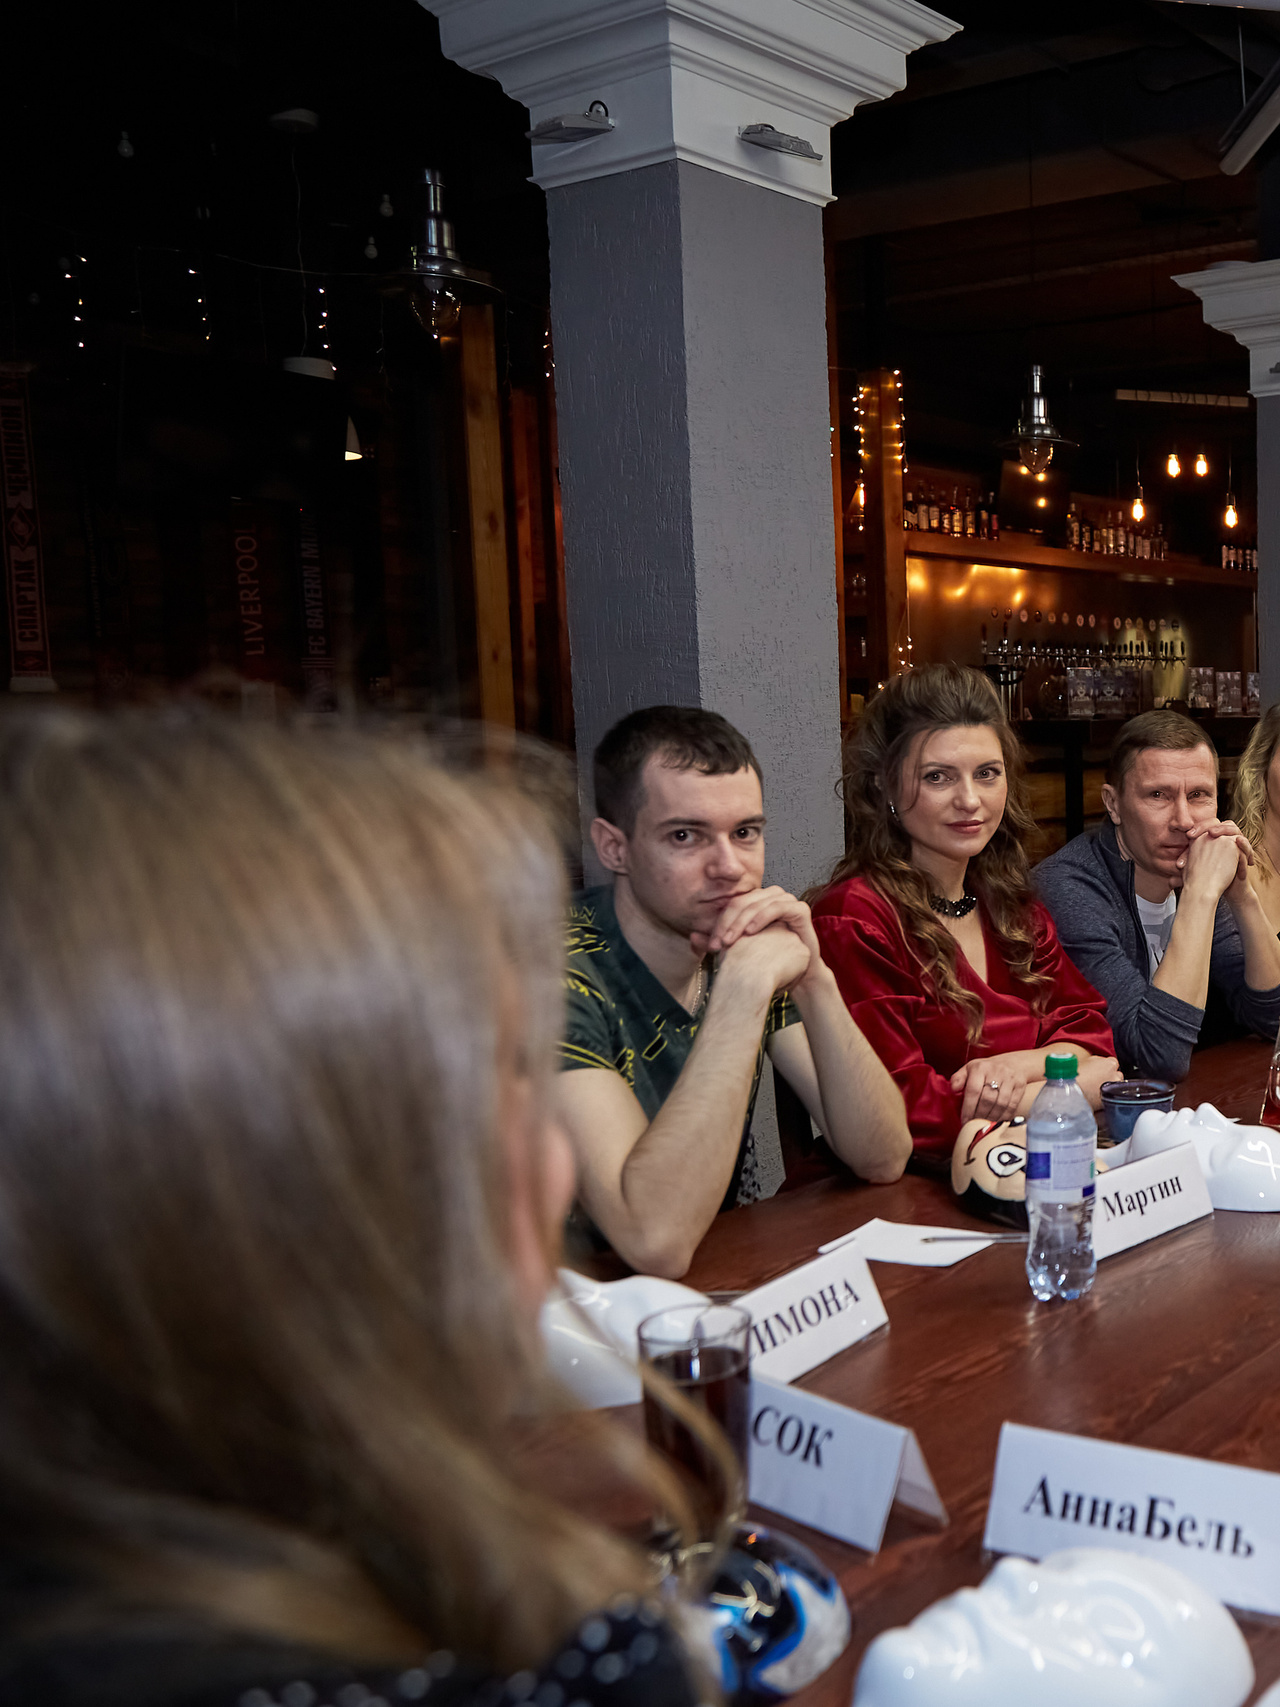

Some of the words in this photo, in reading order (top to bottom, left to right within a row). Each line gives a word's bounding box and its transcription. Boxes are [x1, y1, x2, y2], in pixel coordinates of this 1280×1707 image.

[1, 404, 31, 498] ЧЕМПИОН
[18, 558, 40, 643] СПАРТАК
[233, 527, 265, 656] LIVERPOOL
[303, 565, 325, 629] BAYERN
[1102, 1175, 1183, 1222] Мартин
[751, 1278, 861, 1361] ИМОНА
[1023, 1473, 1255, 1558] АннаБель
